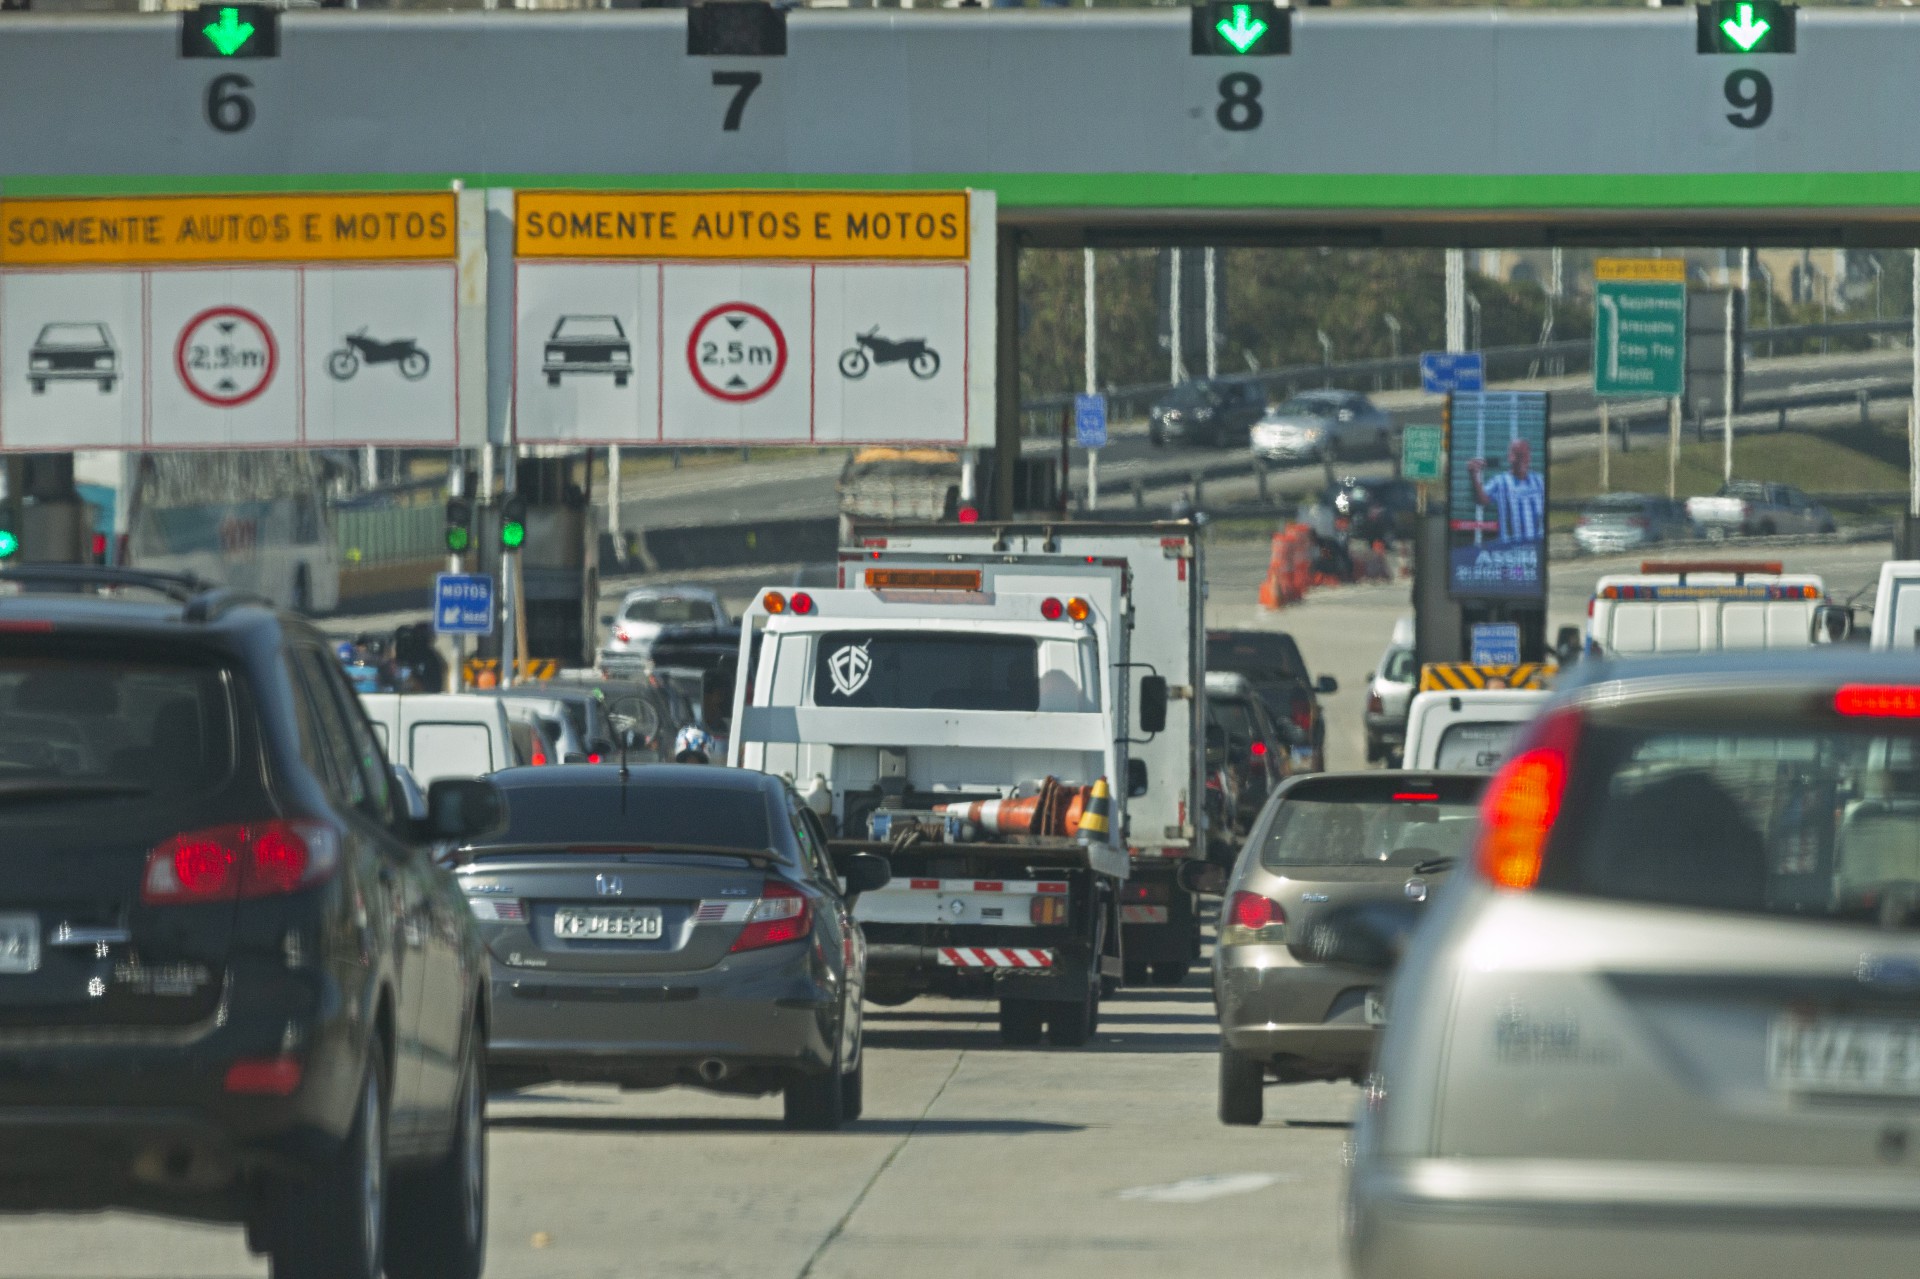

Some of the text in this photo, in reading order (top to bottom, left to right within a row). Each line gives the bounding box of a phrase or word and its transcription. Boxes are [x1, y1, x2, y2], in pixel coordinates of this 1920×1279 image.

[205, 74, 256, 133] 6
[711, 71, 762, 131] 7
[1215, 71, 1264, 131] 8
[1723, 68, 1773, 129] 9
[8, 212, 447, 246] SOMENTE AUTOS E MOTOS
[526, 212, 958, 239] SOMENTE AUTOS E MOTOS
[442, 583, 488, 598] MOTOS
